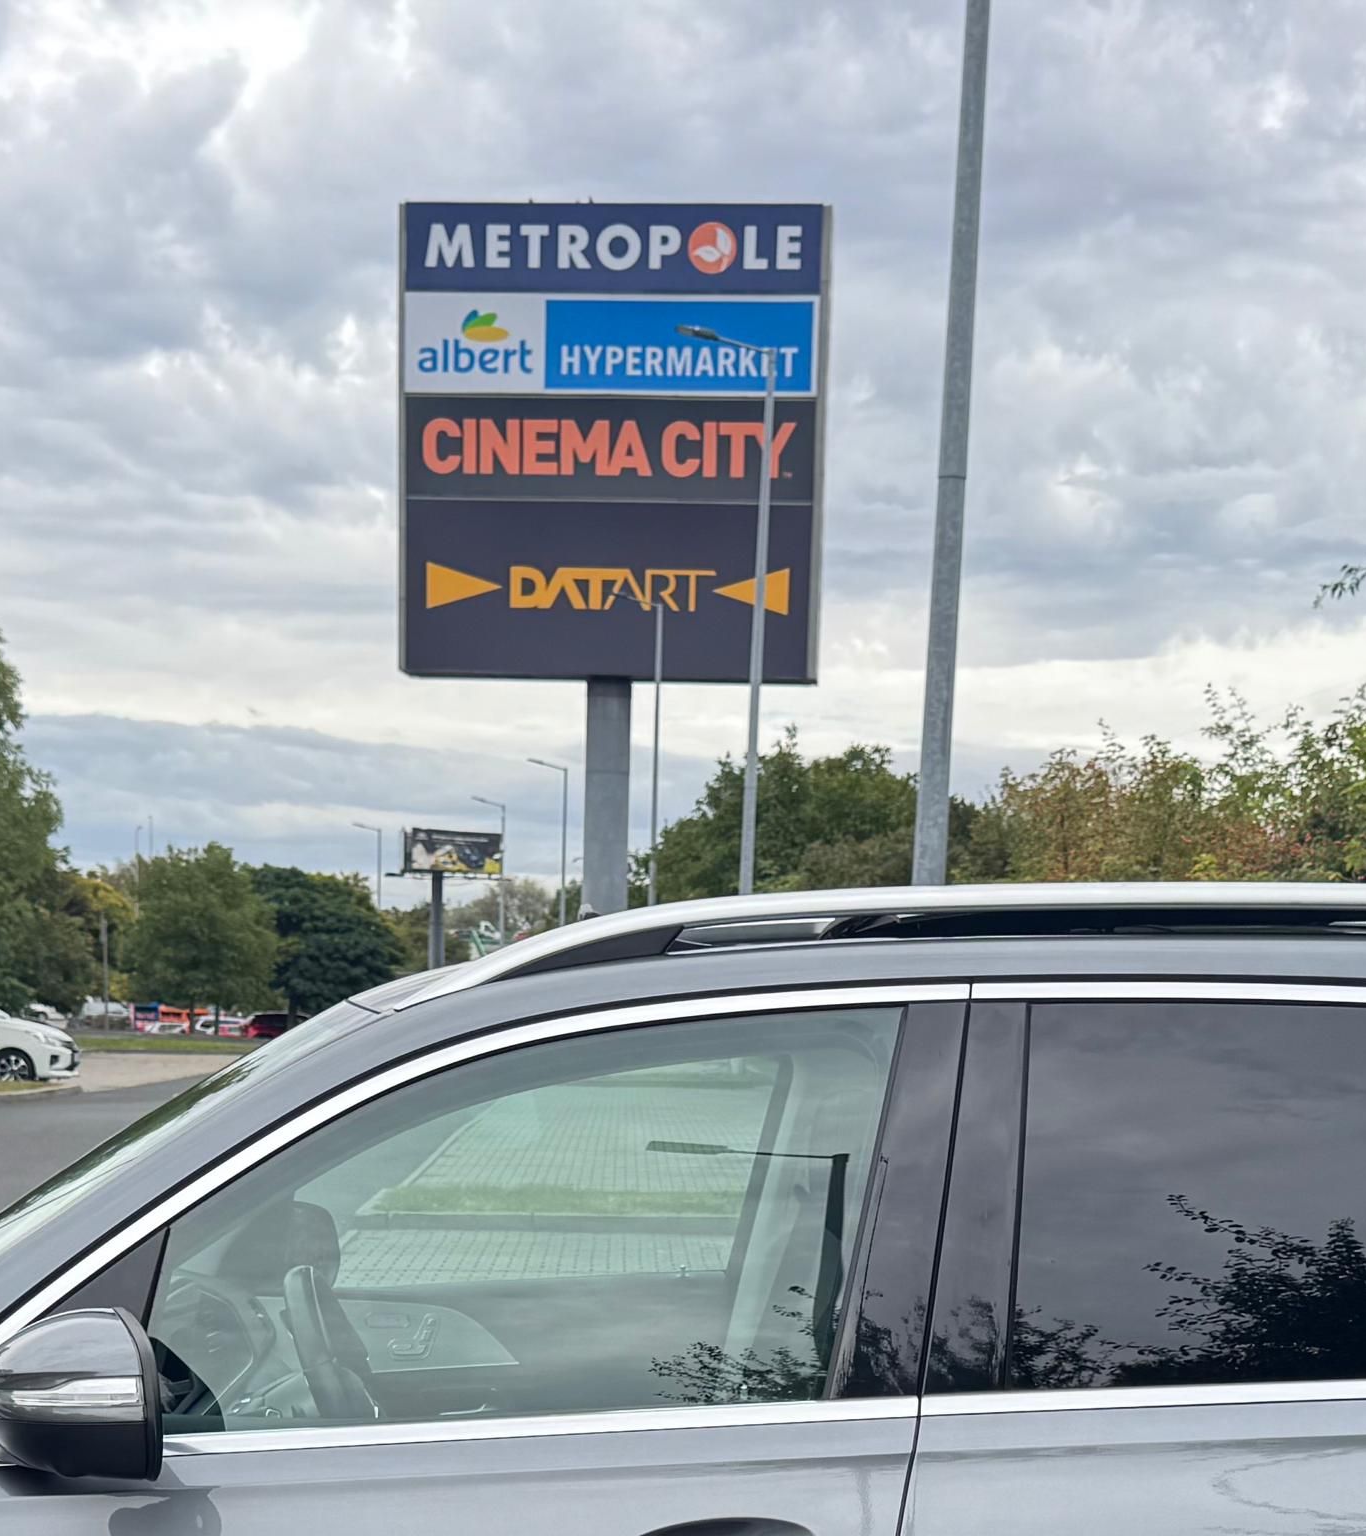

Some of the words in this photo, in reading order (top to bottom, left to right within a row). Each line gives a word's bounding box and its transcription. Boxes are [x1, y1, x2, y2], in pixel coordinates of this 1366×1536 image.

[423, 221, 803, 274] METROPOLE
[417, 338, 533, 375] albert
[421, 417, 653, 477] CINEMA
[661, 420, 798, 480] CITY
[509, 565, 718, 612] DATART
